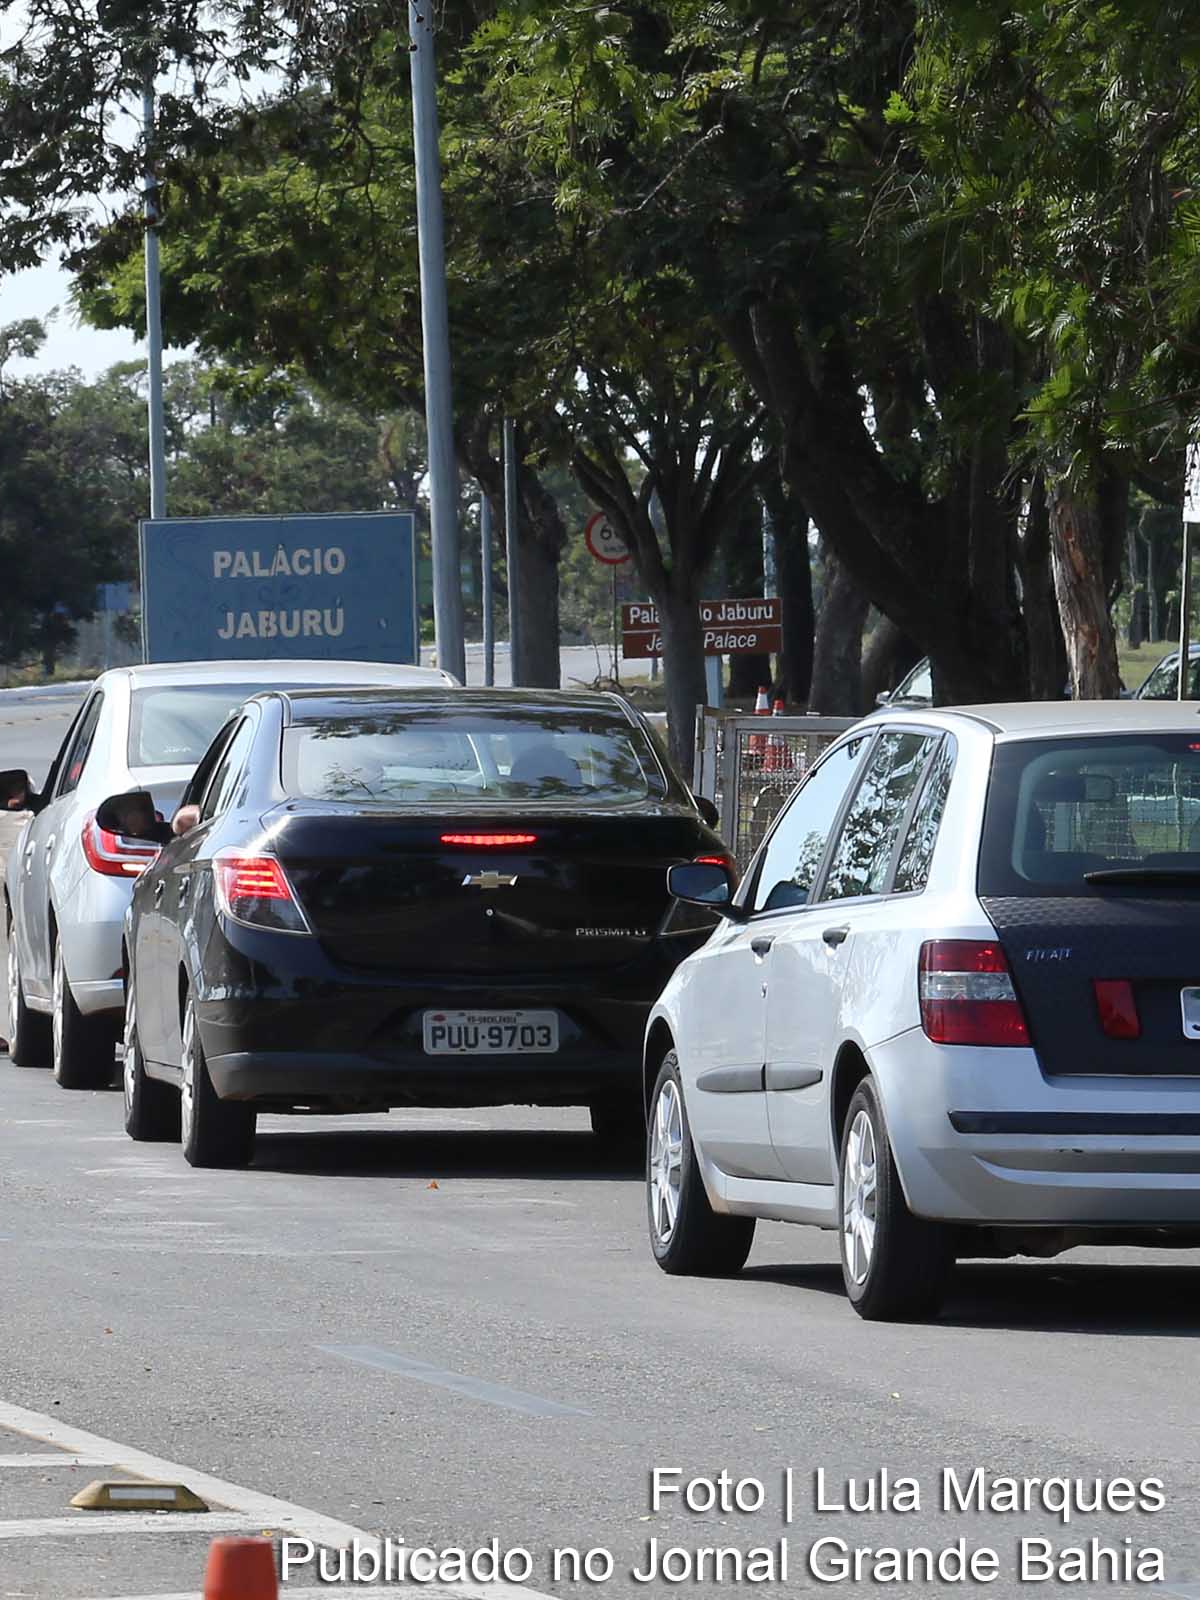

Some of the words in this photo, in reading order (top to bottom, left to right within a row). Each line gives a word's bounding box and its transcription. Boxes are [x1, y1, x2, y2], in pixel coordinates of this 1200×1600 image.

[213, 544, 346, 578] PALÁCIO
[717, 603, 773, 621] Jaburu
[703, 631, 757, 649] Palace
